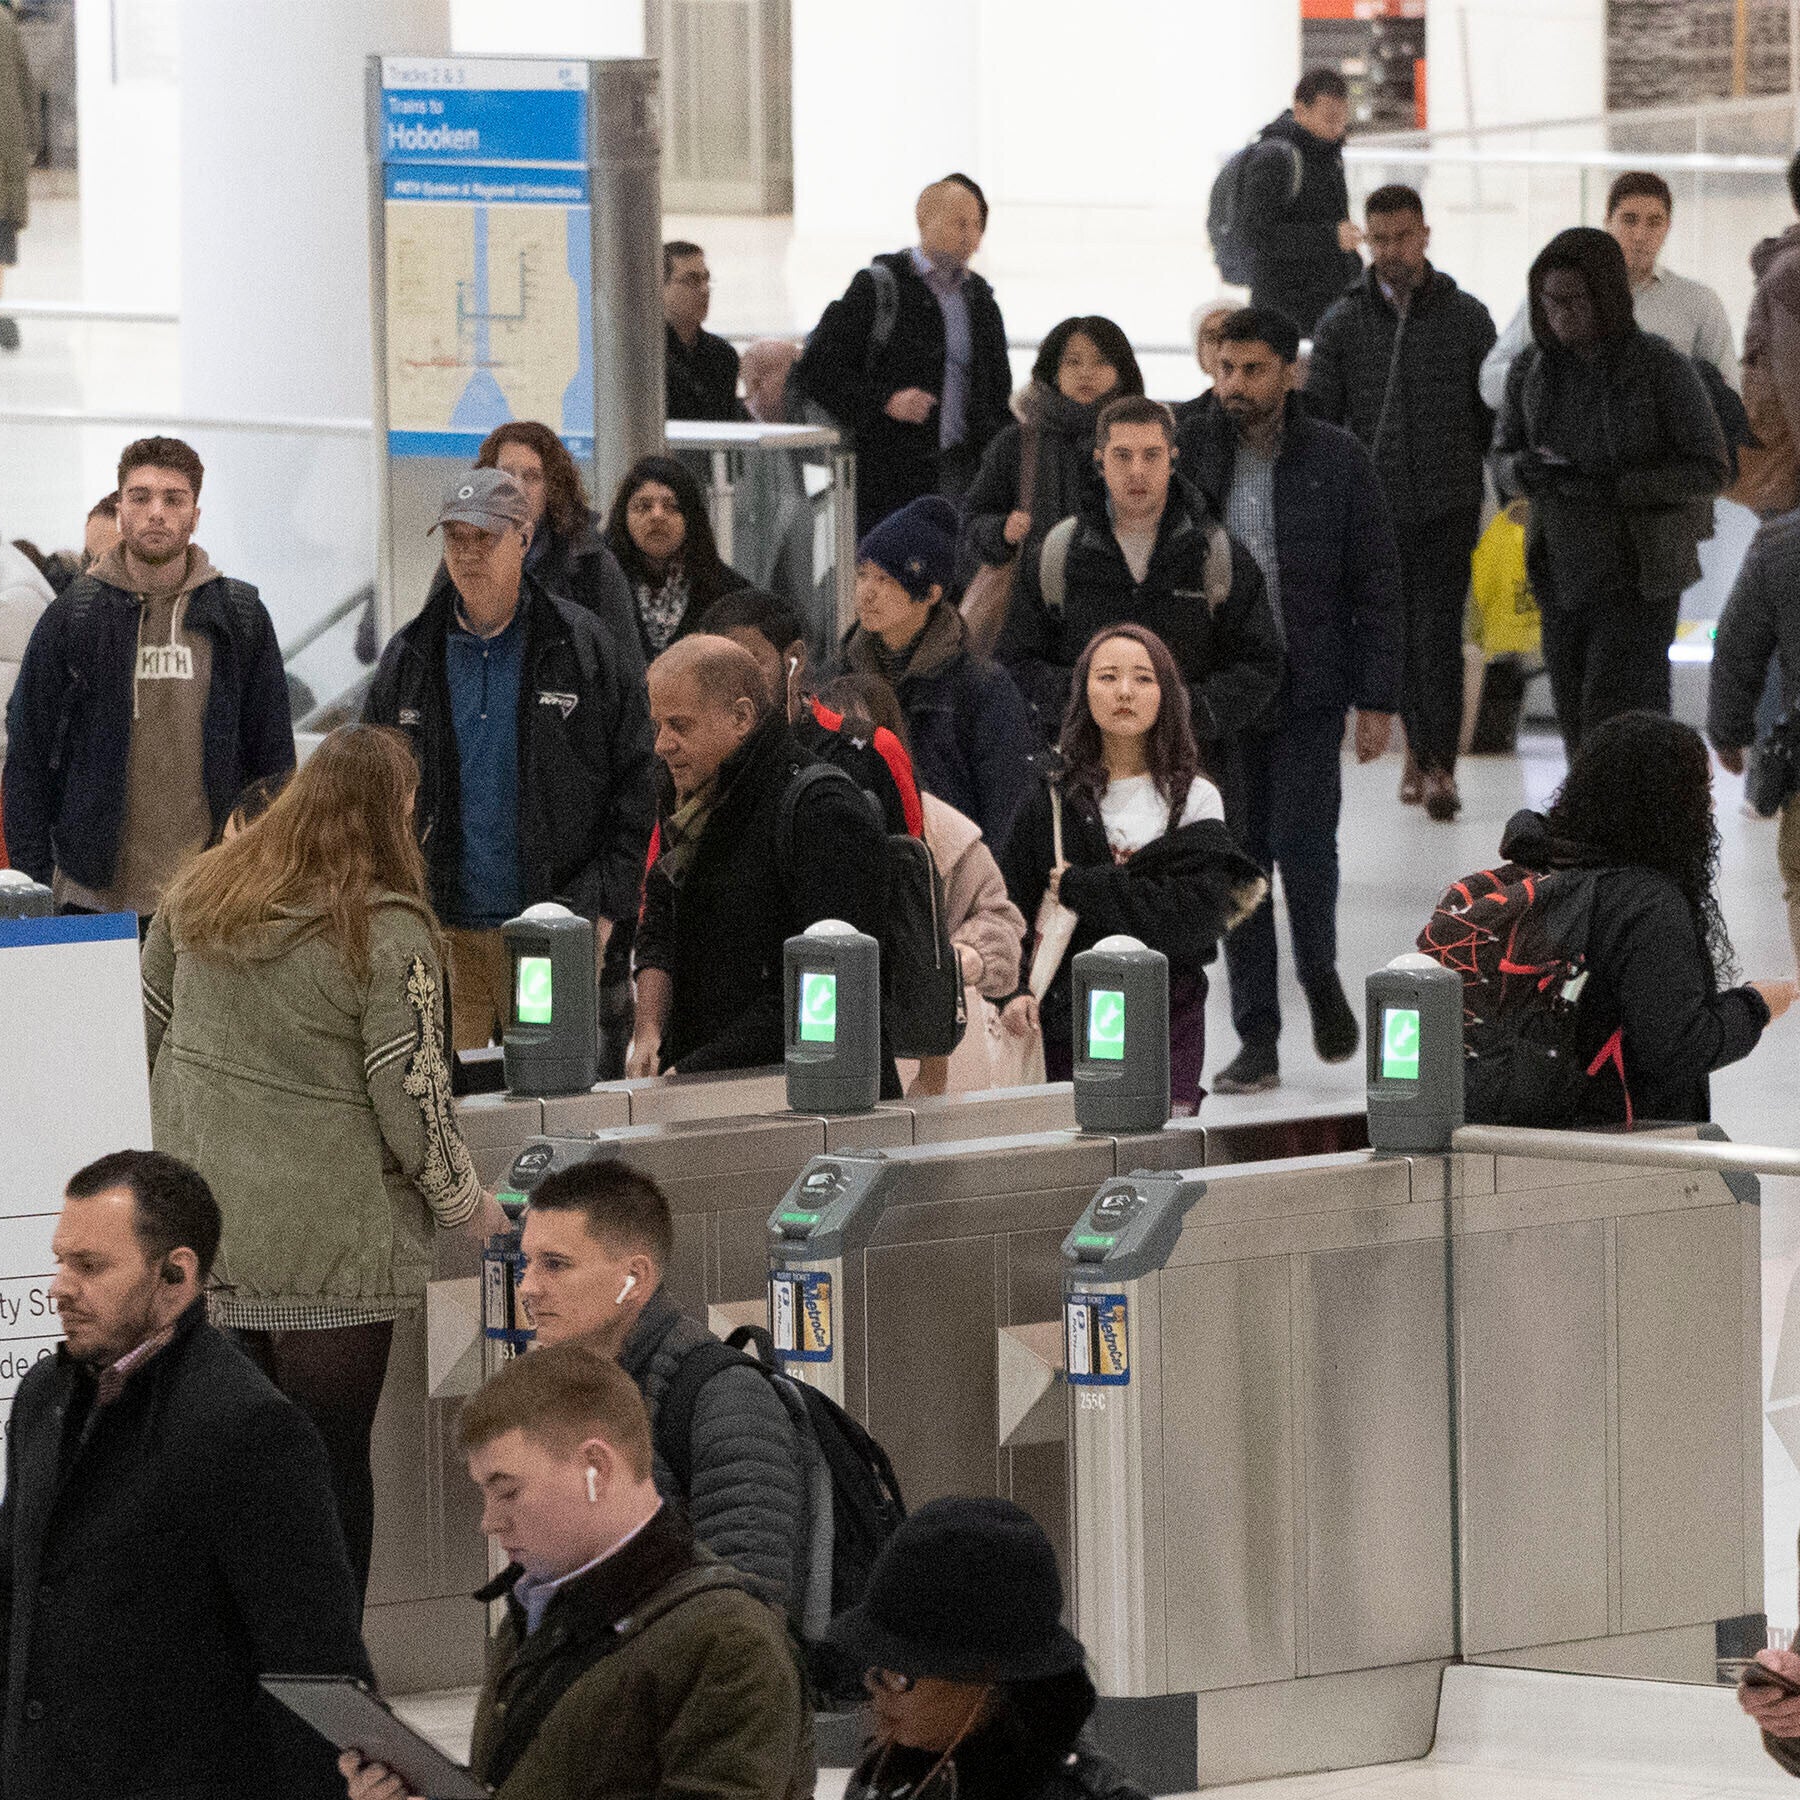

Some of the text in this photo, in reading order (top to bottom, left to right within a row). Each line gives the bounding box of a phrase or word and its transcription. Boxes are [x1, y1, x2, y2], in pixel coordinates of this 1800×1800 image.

[388, 123, 479, 150] Hoboken
[142, 650, 188, 674] KITH
[1080, 1391, 1107, 1411] 255C
